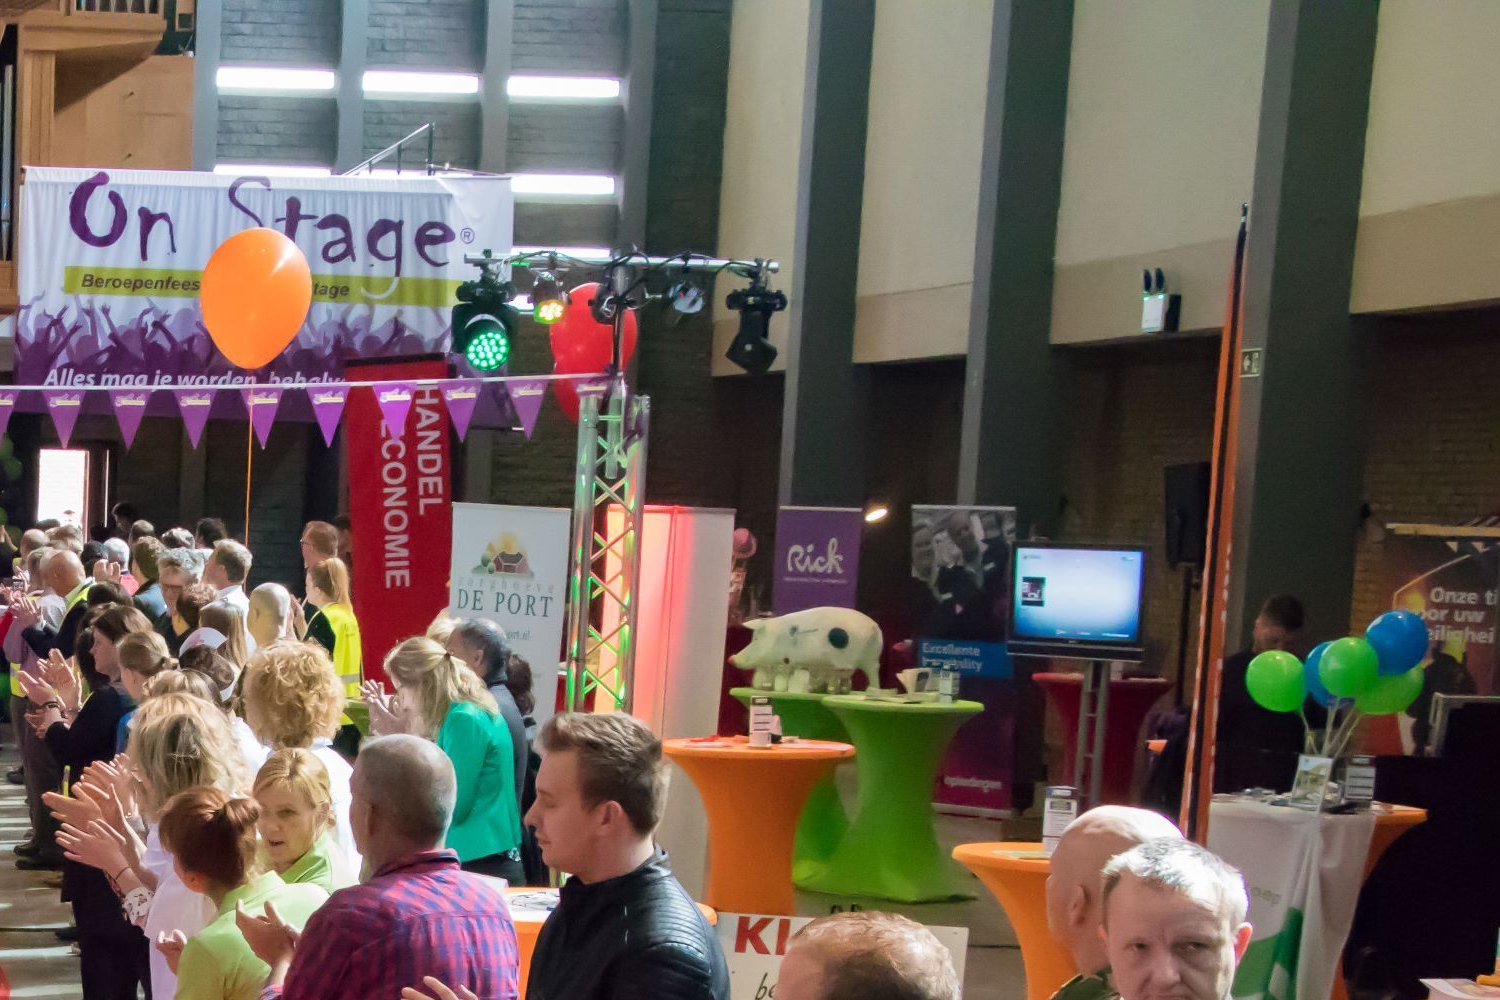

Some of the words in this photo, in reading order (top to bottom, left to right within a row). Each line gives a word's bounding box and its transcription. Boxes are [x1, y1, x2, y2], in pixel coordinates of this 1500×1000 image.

[69, 172, 177, 262] On
[227, 176, 456, 300] Stage
[43, 368, 96, 388] Alles
[151, 369, 173, 392] je
[177, 370, 256, 387] worden
[415, 382, 444, 516] HANDEL
[786, 537, 844, 574] Rick
[457, 588, 483, 610] DE
[493, 591, 553, 618] PORT
[1430, 586, 1478, 604] Onze
[1453, 609, 1485, 623] uw
